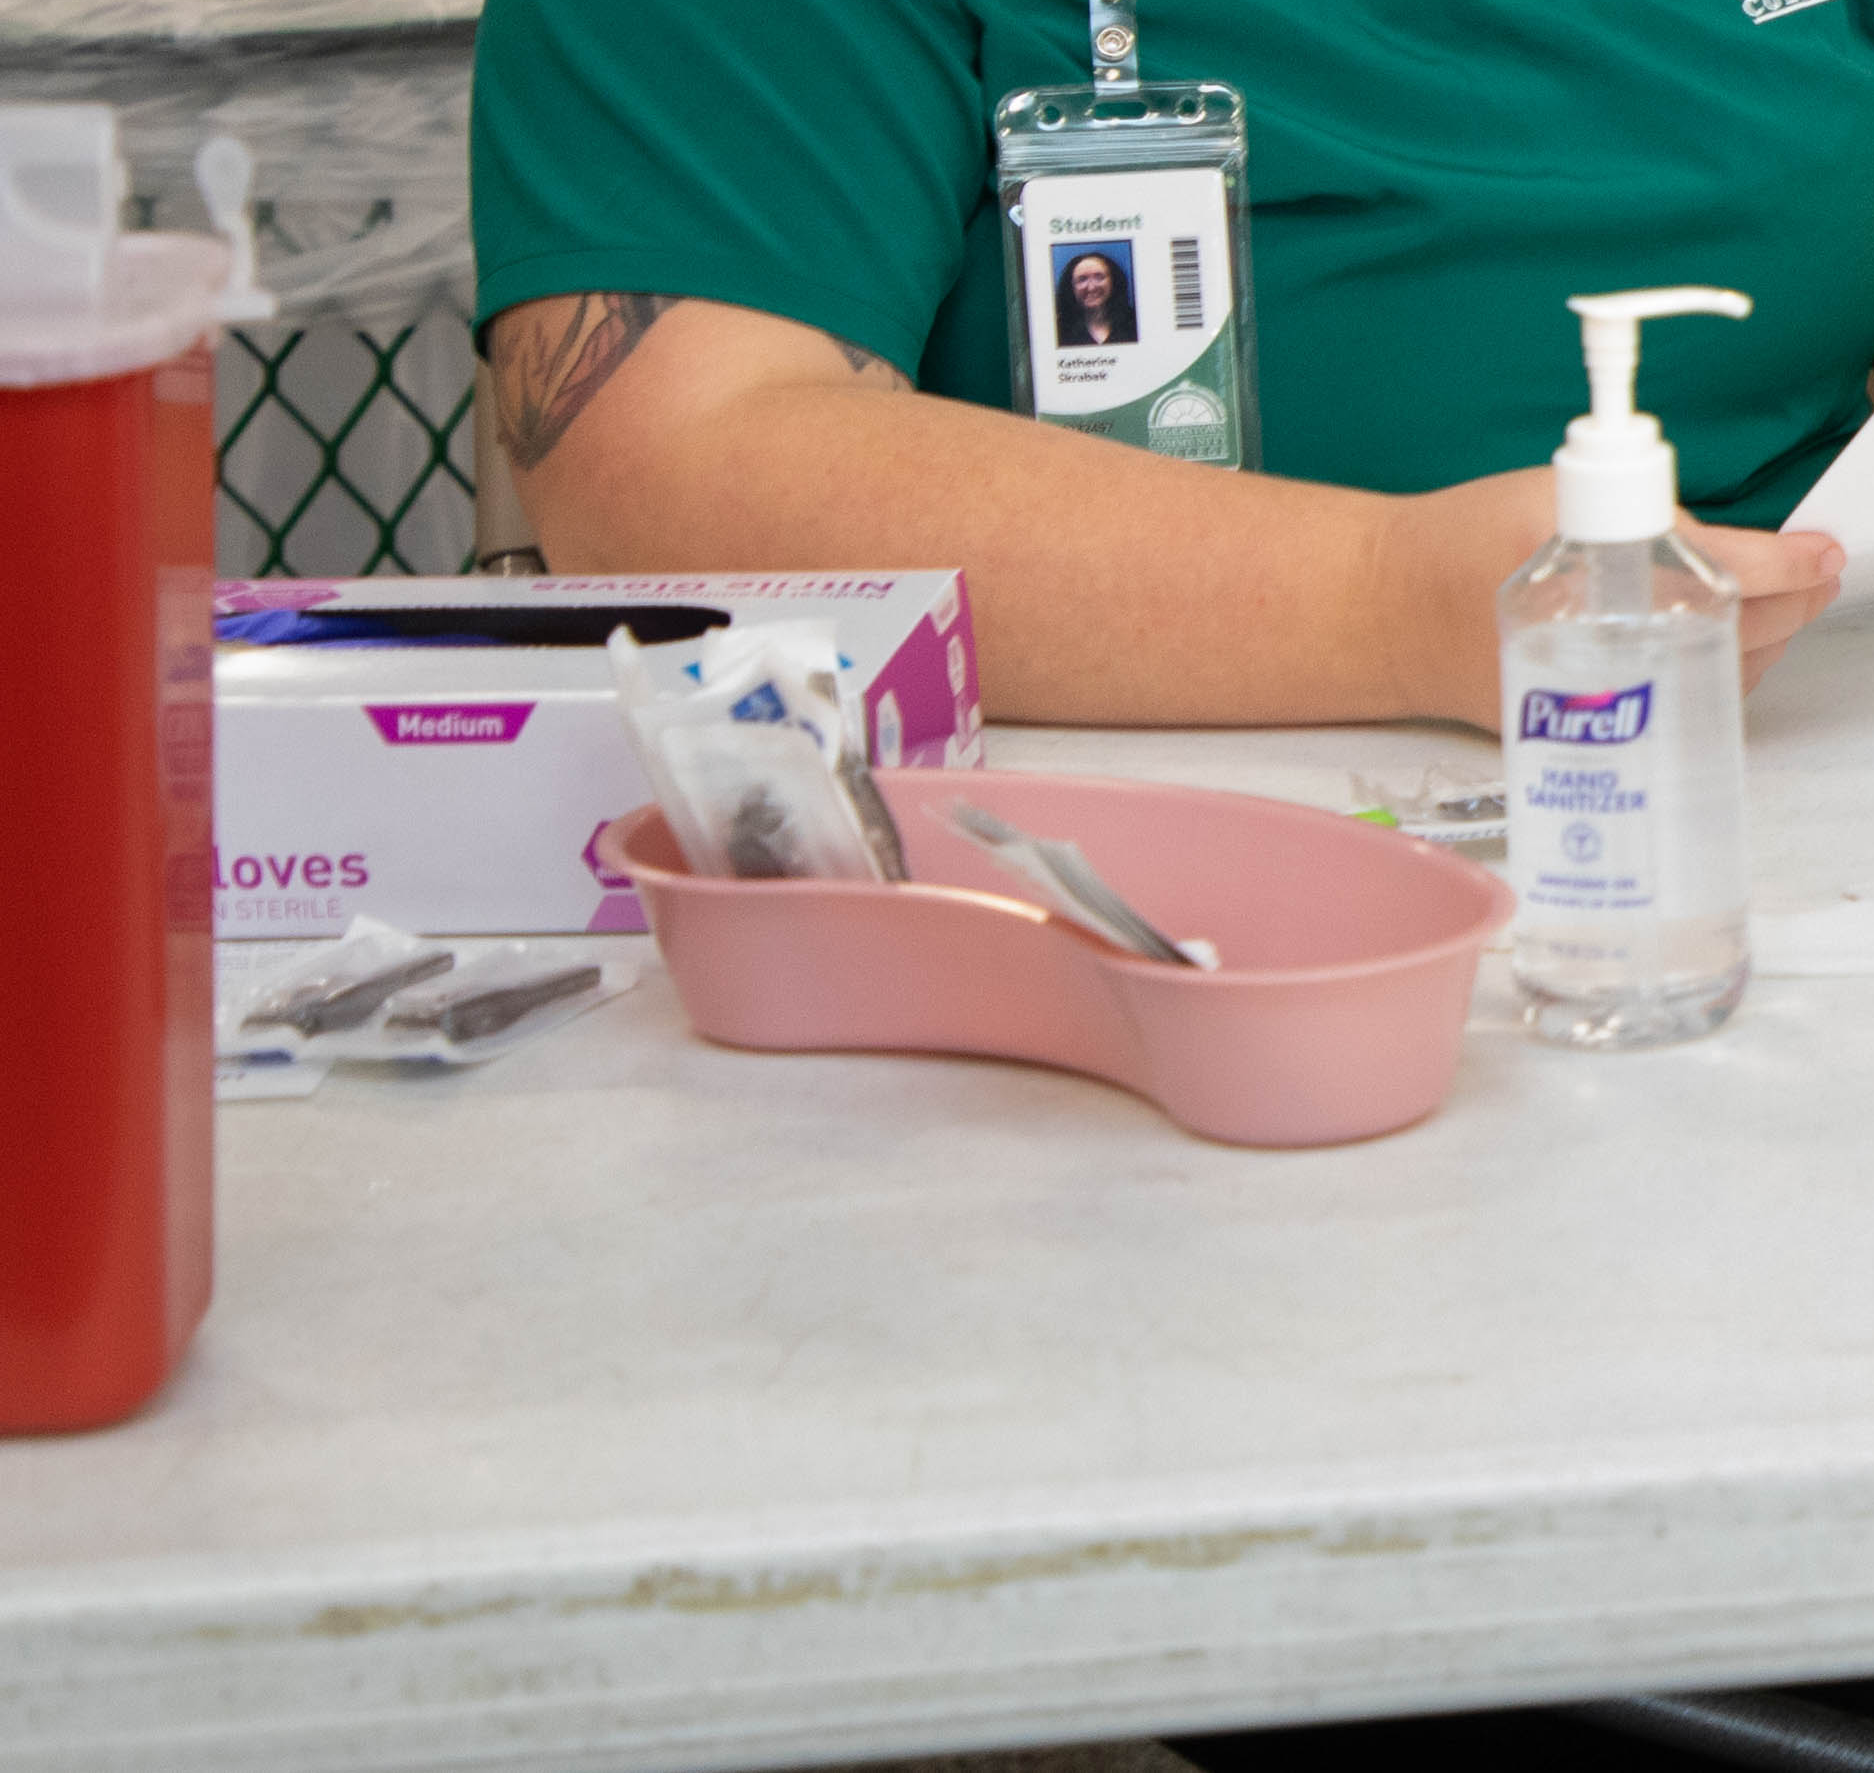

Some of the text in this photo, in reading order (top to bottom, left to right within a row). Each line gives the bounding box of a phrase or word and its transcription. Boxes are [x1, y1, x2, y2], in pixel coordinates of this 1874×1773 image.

[1048, 214, 1142, 234] Student
[529, 581, 708, 593] Gloves
[398, 714, 503, 739] Medium
[1526, 694, 1643, 740] Purell
[1541, 768, 1619, 789] HAND
[1525, 784, 1646, 812] SANITIZER
[213, 846, 369, 890] loves
[235, 896, 344, 921] STERILE
